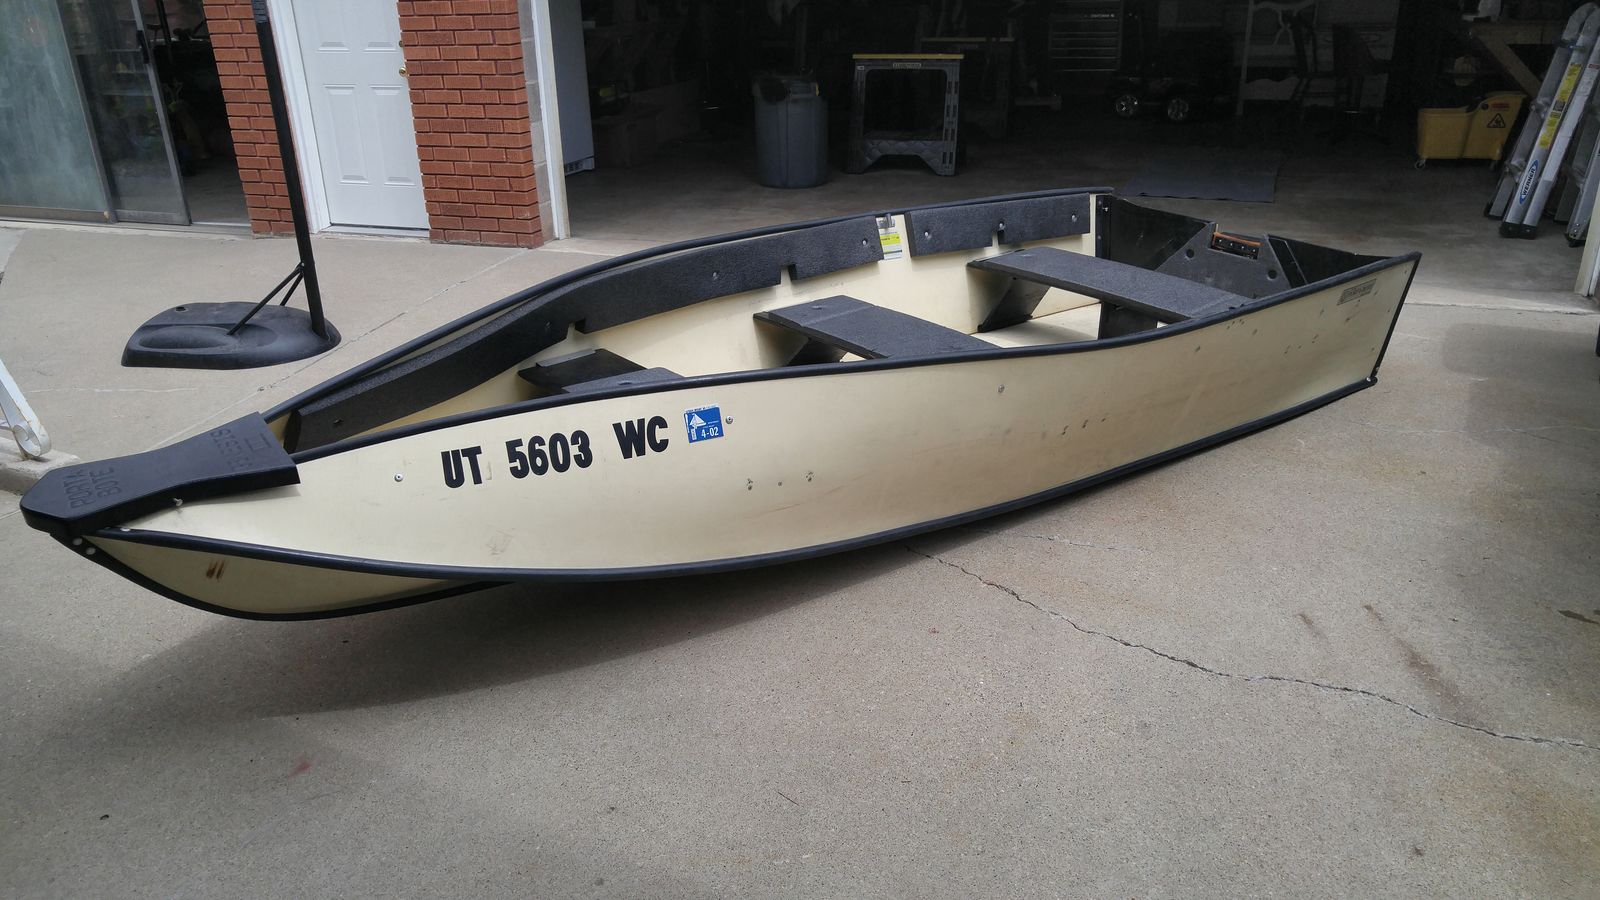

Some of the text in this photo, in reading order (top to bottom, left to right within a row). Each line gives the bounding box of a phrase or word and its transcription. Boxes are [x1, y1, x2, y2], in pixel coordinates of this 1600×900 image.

[1522, 166, 1537, 197] WERNER
[701, 426, 719, 438] 4-02
[441, 446, 483, 488] UT
[505, 430, 593, 479] 5603
[612, 415, 669, 460] WC
[63, 468, 97, 509] PORTA
[89, 466, 123, 498] BOTE
